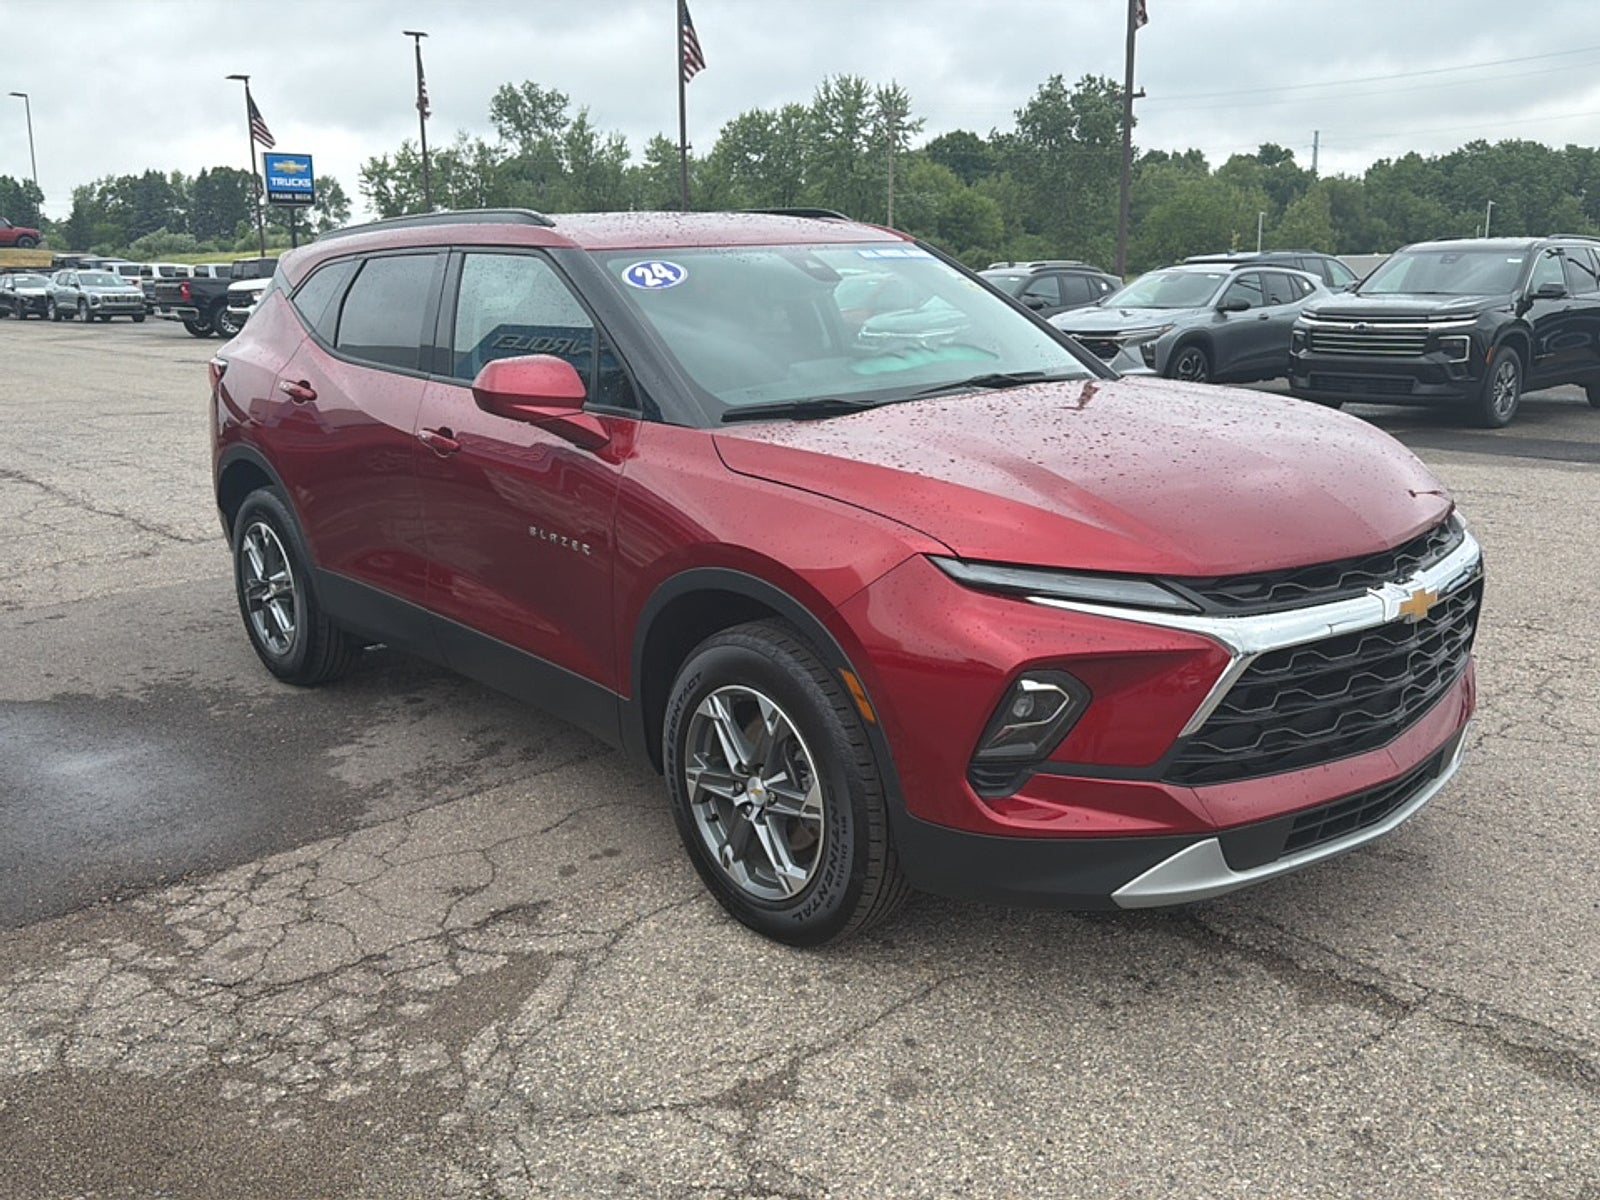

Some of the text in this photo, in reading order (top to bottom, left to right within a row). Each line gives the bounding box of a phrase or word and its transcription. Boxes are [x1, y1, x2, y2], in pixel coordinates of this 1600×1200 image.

[269, 176, 312, 188] TRUCKS
[634, 262, 677, 287] 24
[528, 525, 592, 557] BLAZER
[792, 768, 841, 922] ONTINENTAL
